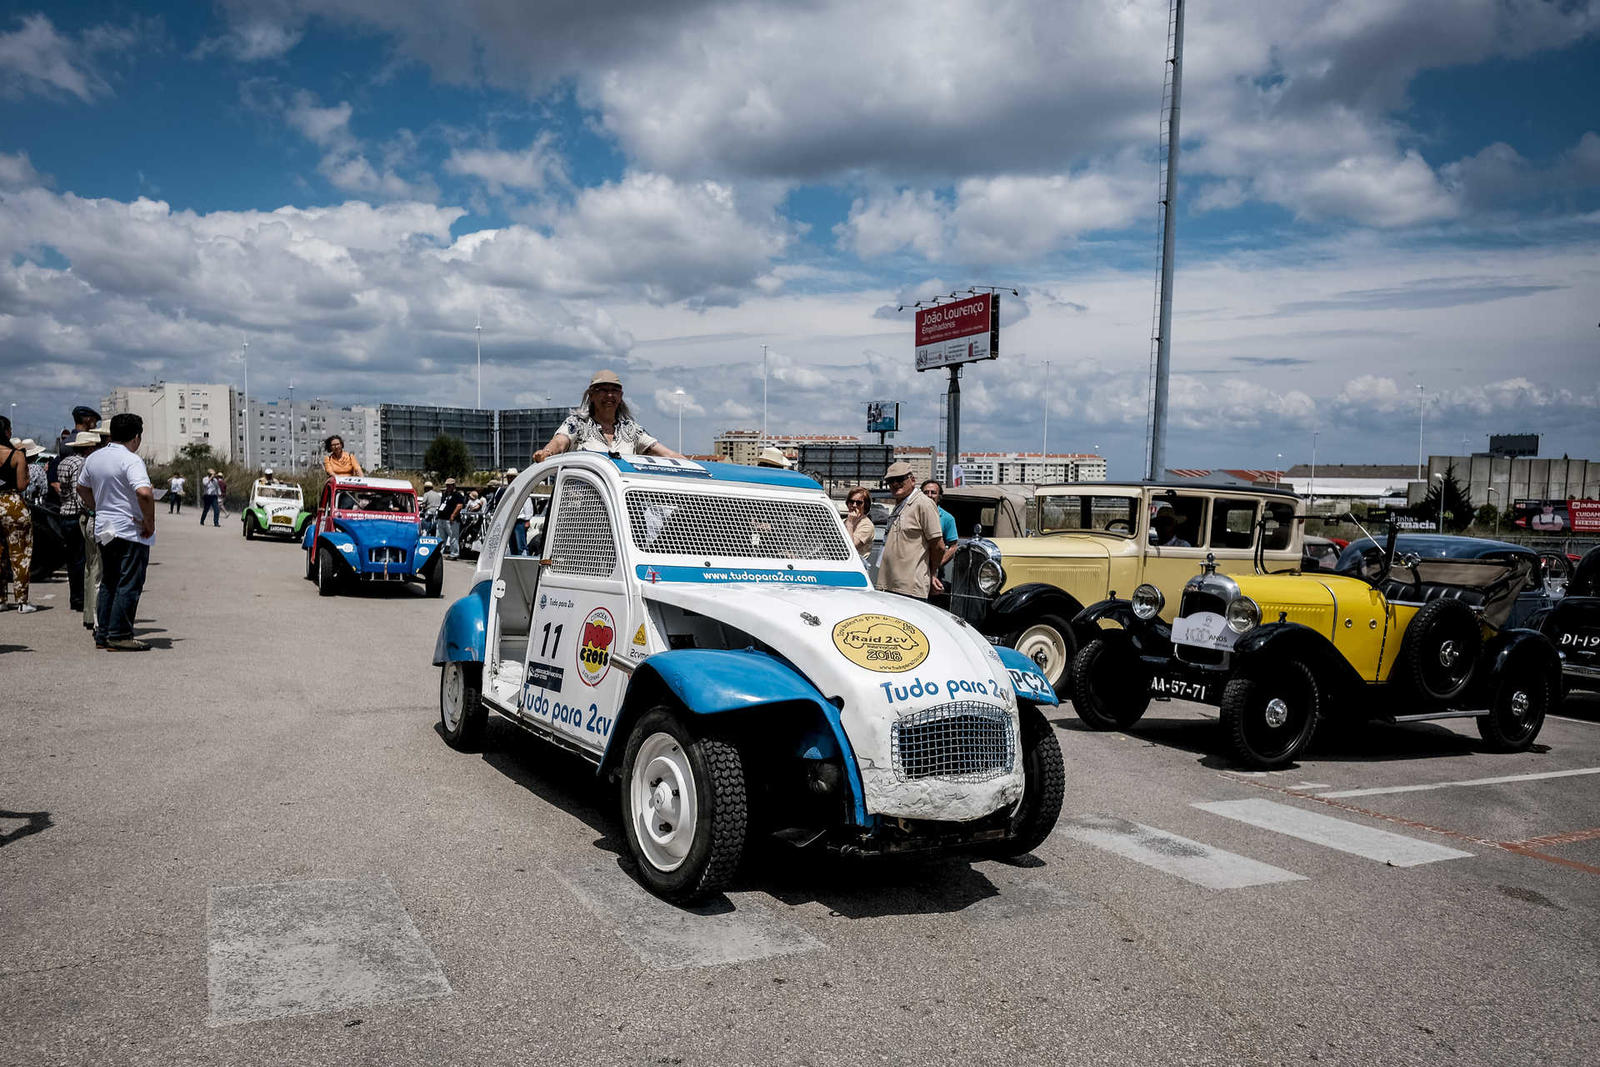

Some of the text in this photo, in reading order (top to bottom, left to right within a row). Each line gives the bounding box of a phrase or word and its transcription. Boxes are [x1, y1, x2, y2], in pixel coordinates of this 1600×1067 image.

[922, 302, 984, 325] João Lourenço
[703, 571, 818, 583] www.tudopara2cv.com
[541, 622, 563, 659] 11
[582, 622, 613, 650] POP
[852, 634, 908, 644] Raid 2cv
[580, 647, 609, 666] CROSS
[867, 649, 903, 662] 2018
[880, 677, 939, 704] Tudo
[946, 679, 988, 700] para
[1008, 669, 1050, 694] PC2
[1151, 677, 1206, 700] AA-57-71
[521, 683, 612, 737] Tudo para 2cv
